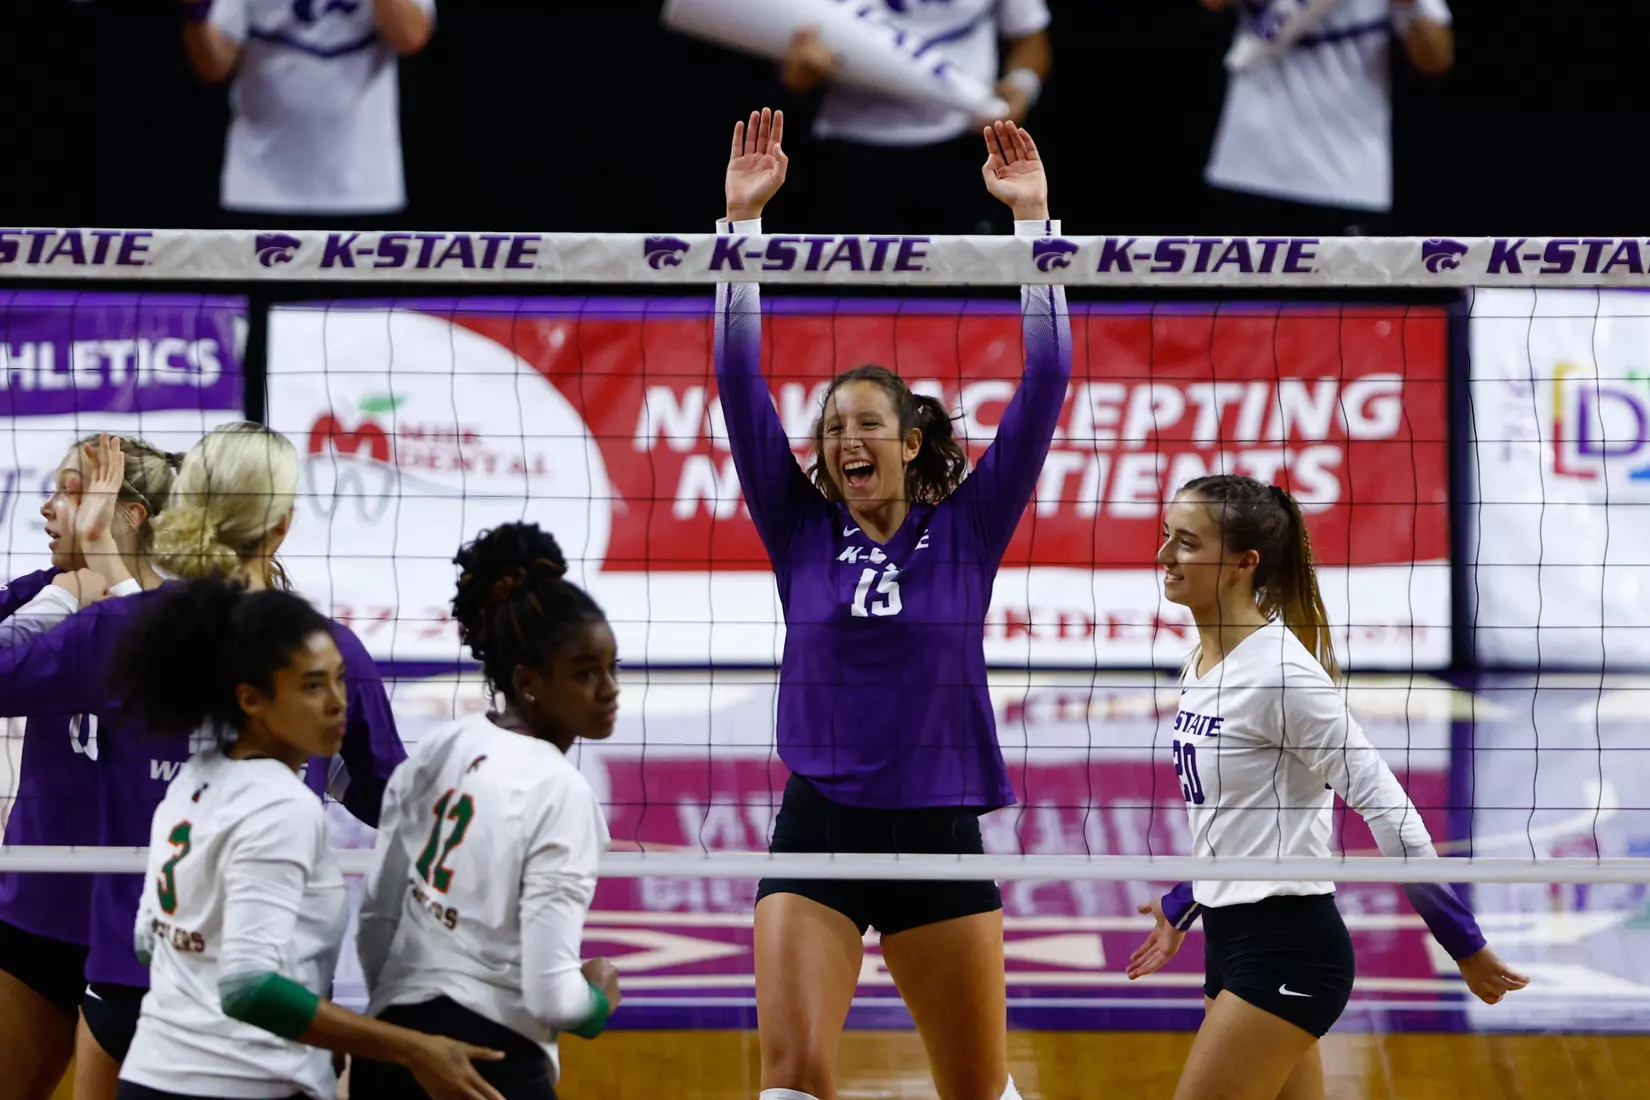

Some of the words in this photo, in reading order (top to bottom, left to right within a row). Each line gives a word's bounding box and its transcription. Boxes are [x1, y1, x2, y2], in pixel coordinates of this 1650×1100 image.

[320, 233, 542, 269] K-STATE
[709, 236, 930, 271] K-STATE
[1098, 238, 1320, 273] K-STATE
[1486, 238, 1650, 274] K-STA
[0, 338, 221, 390] HLETICS
[399, 445, 549, 478] DENTAL
[415, 787, 476, 895] 12
[157, 819, 193, 916] 3
